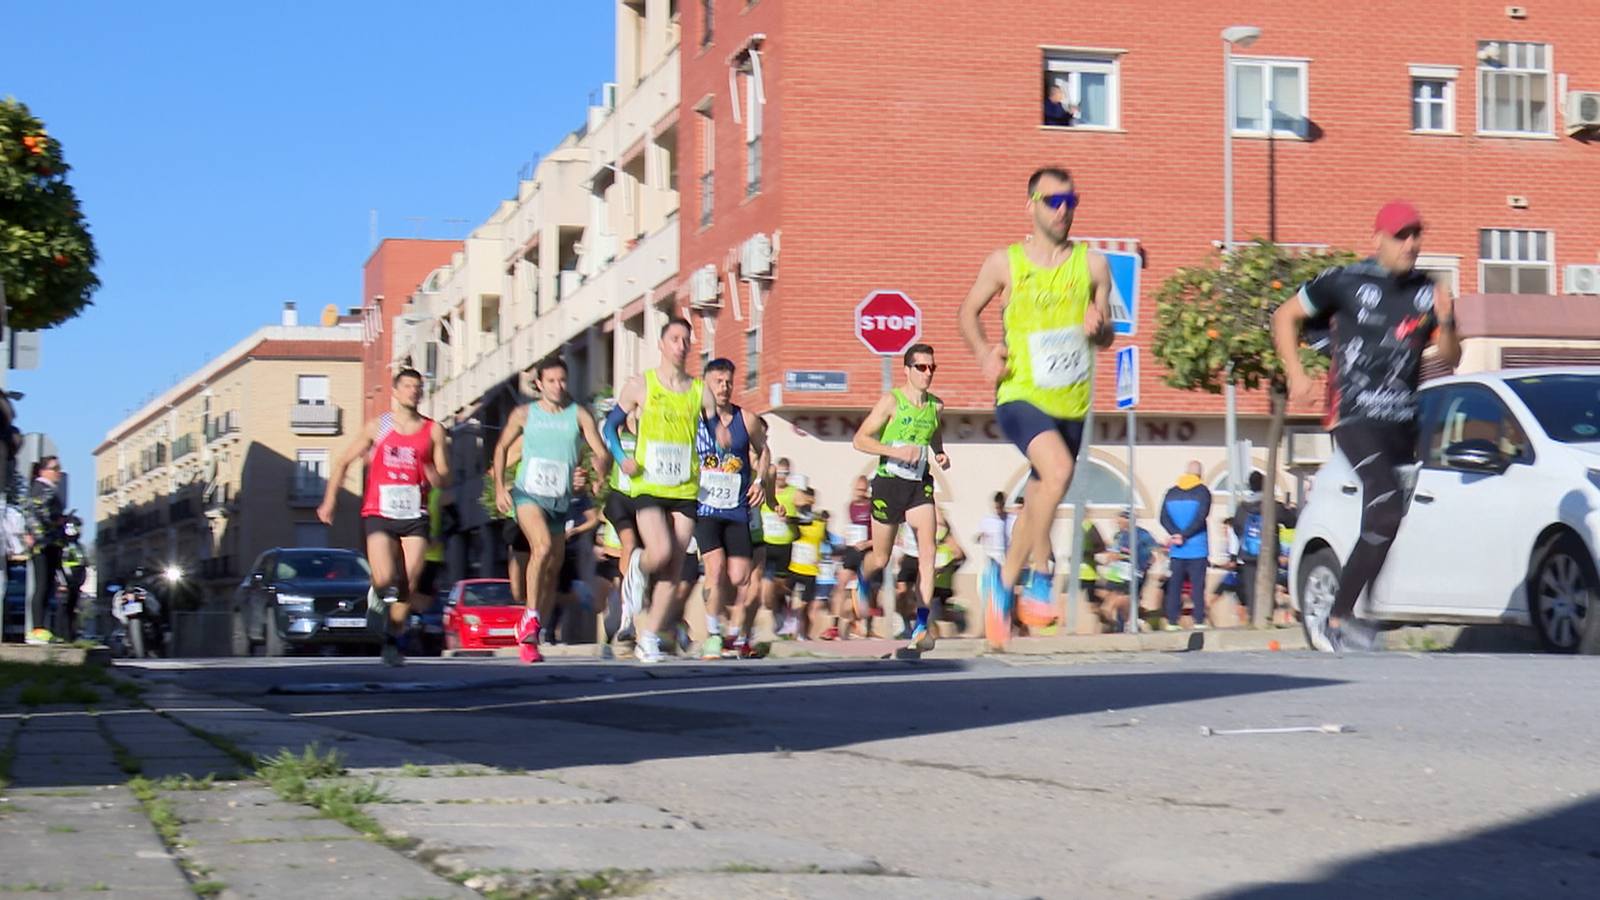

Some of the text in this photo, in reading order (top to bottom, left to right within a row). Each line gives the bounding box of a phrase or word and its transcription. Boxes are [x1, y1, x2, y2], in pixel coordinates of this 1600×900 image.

[860, 315, 916, 331] STOP
[655, 461, 682, 477] 238
[708, 486, 731, 500] 423
